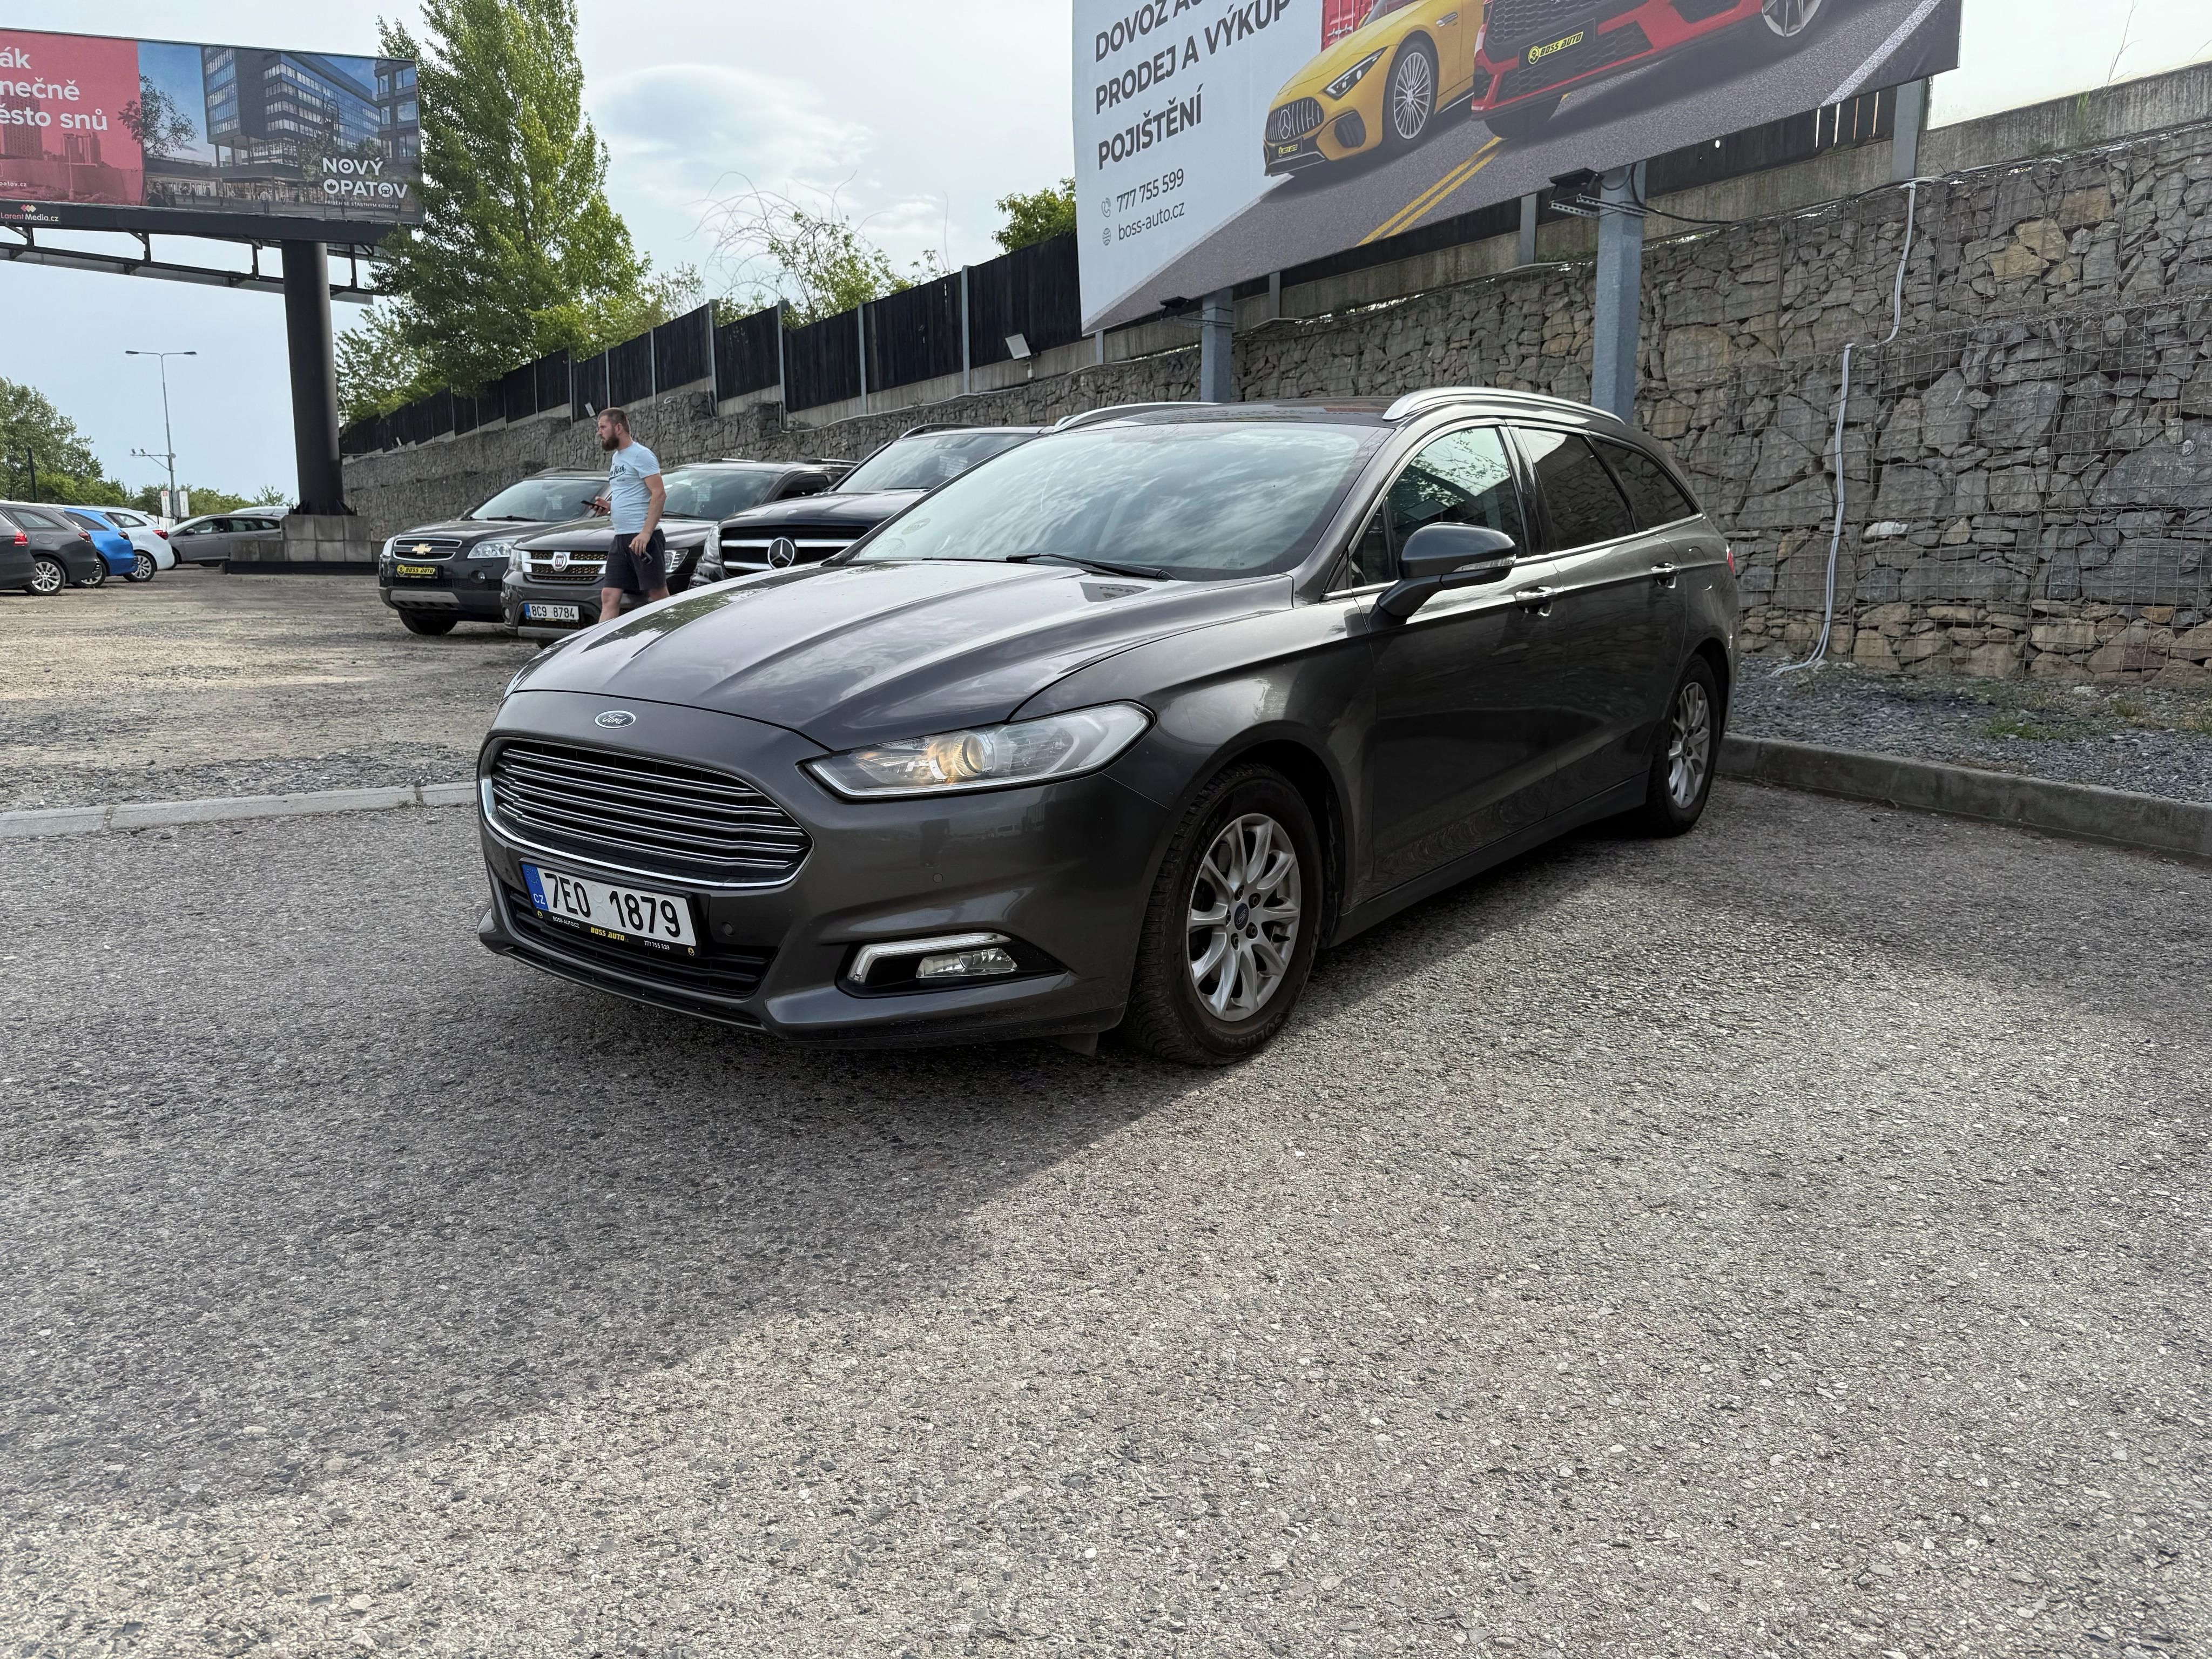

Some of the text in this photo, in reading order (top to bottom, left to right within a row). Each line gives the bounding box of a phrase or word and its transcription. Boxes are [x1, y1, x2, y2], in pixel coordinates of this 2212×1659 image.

[1096, 0, 1169, 63] DOVOZ
[1540, 33, 1582, 56] BOSS AUTO
[1096, 0, 1290, 116] PRODEJ A VÝKUP
[60, 108, 108, 130] snů
[1098, 83, 1204, 171] POJIŠTĚNÍ
[322, 157, 383, 176] NOVÝ
[323, 179, 408, 199] OPATOV
[1116, 168, 1184, 213] 777 755 599
[1118, 202, 1185, 241] boss-auto.cz
[531, 606, 547, 617] 8C9
[553, 607, 575, 618] 8784
[602, 713, 627, 724] Ford
[533, 893, 546, 905] CZ
[609, 891, 681, 938] 1879
[590, 927, 606, 936] BOSS
